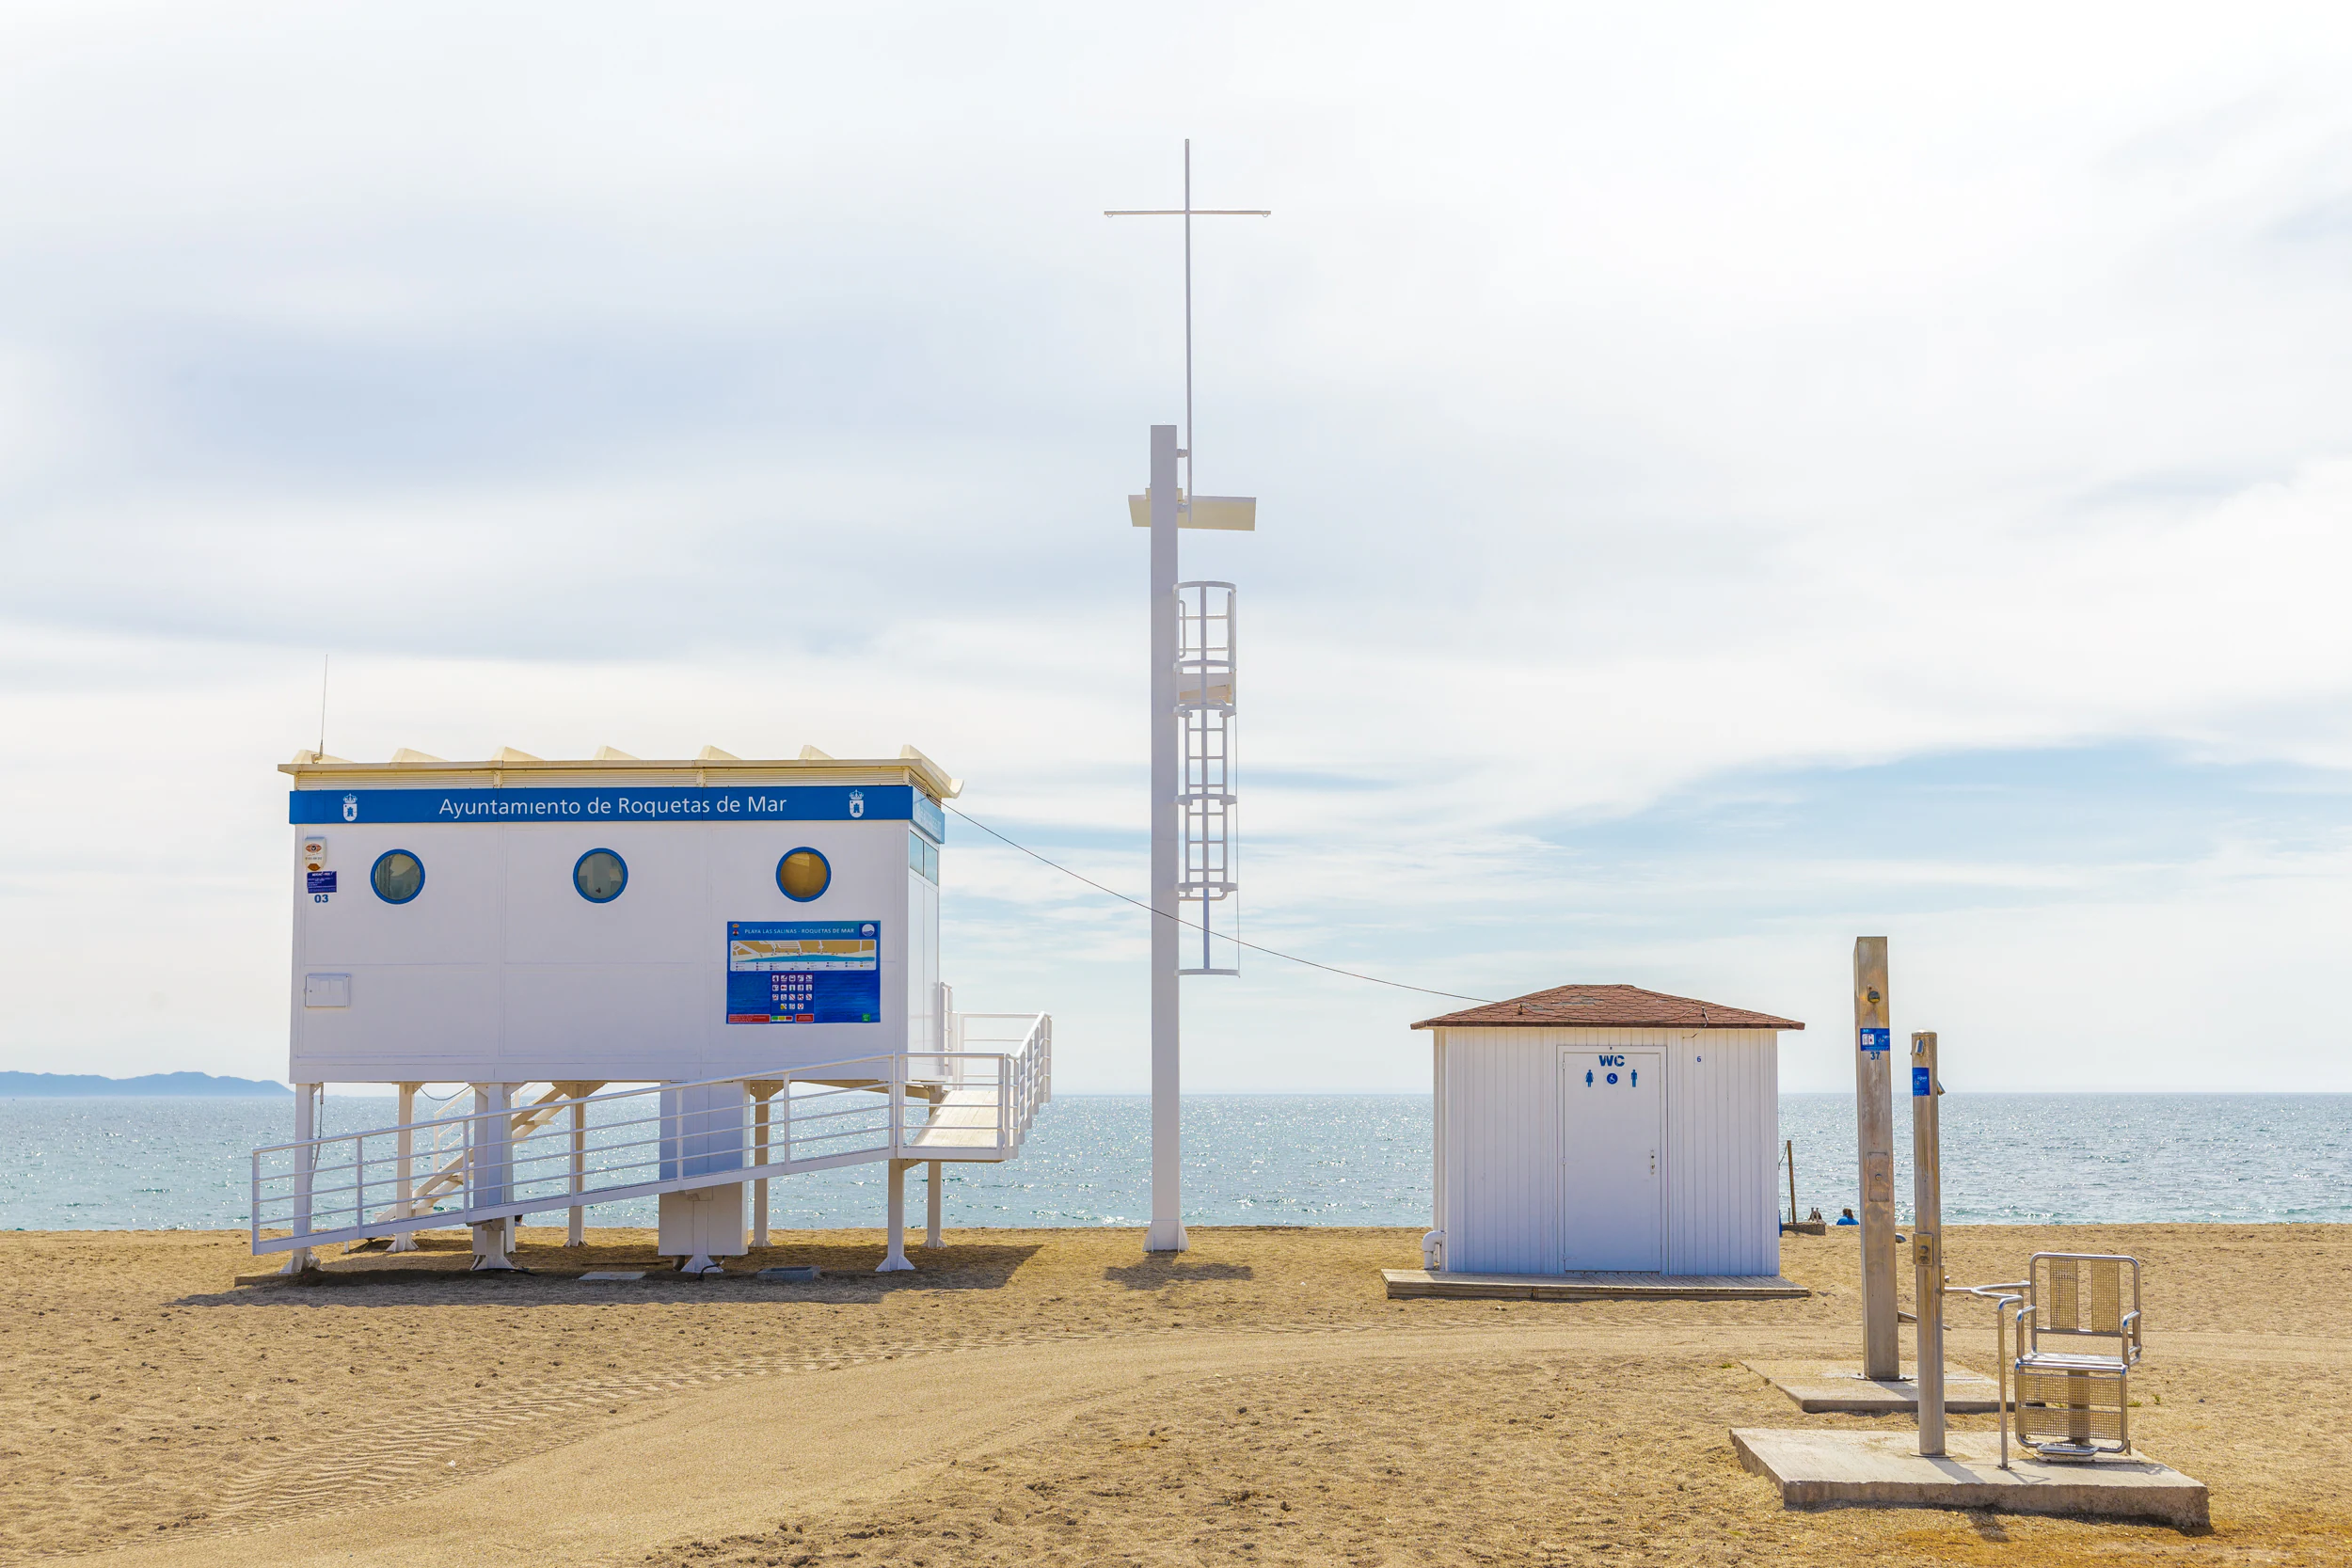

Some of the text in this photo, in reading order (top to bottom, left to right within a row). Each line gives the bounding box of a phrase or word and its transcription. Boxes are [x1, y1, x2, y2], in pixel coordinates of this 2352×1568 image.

[438, 796, 787, 818] Ayuntamiento de Roquetas de Mar
[314, 895, 329, 903] 03
[1598, 1054, 1625, 1067] WC
[1870, 1052, 1881, 1060] 37
